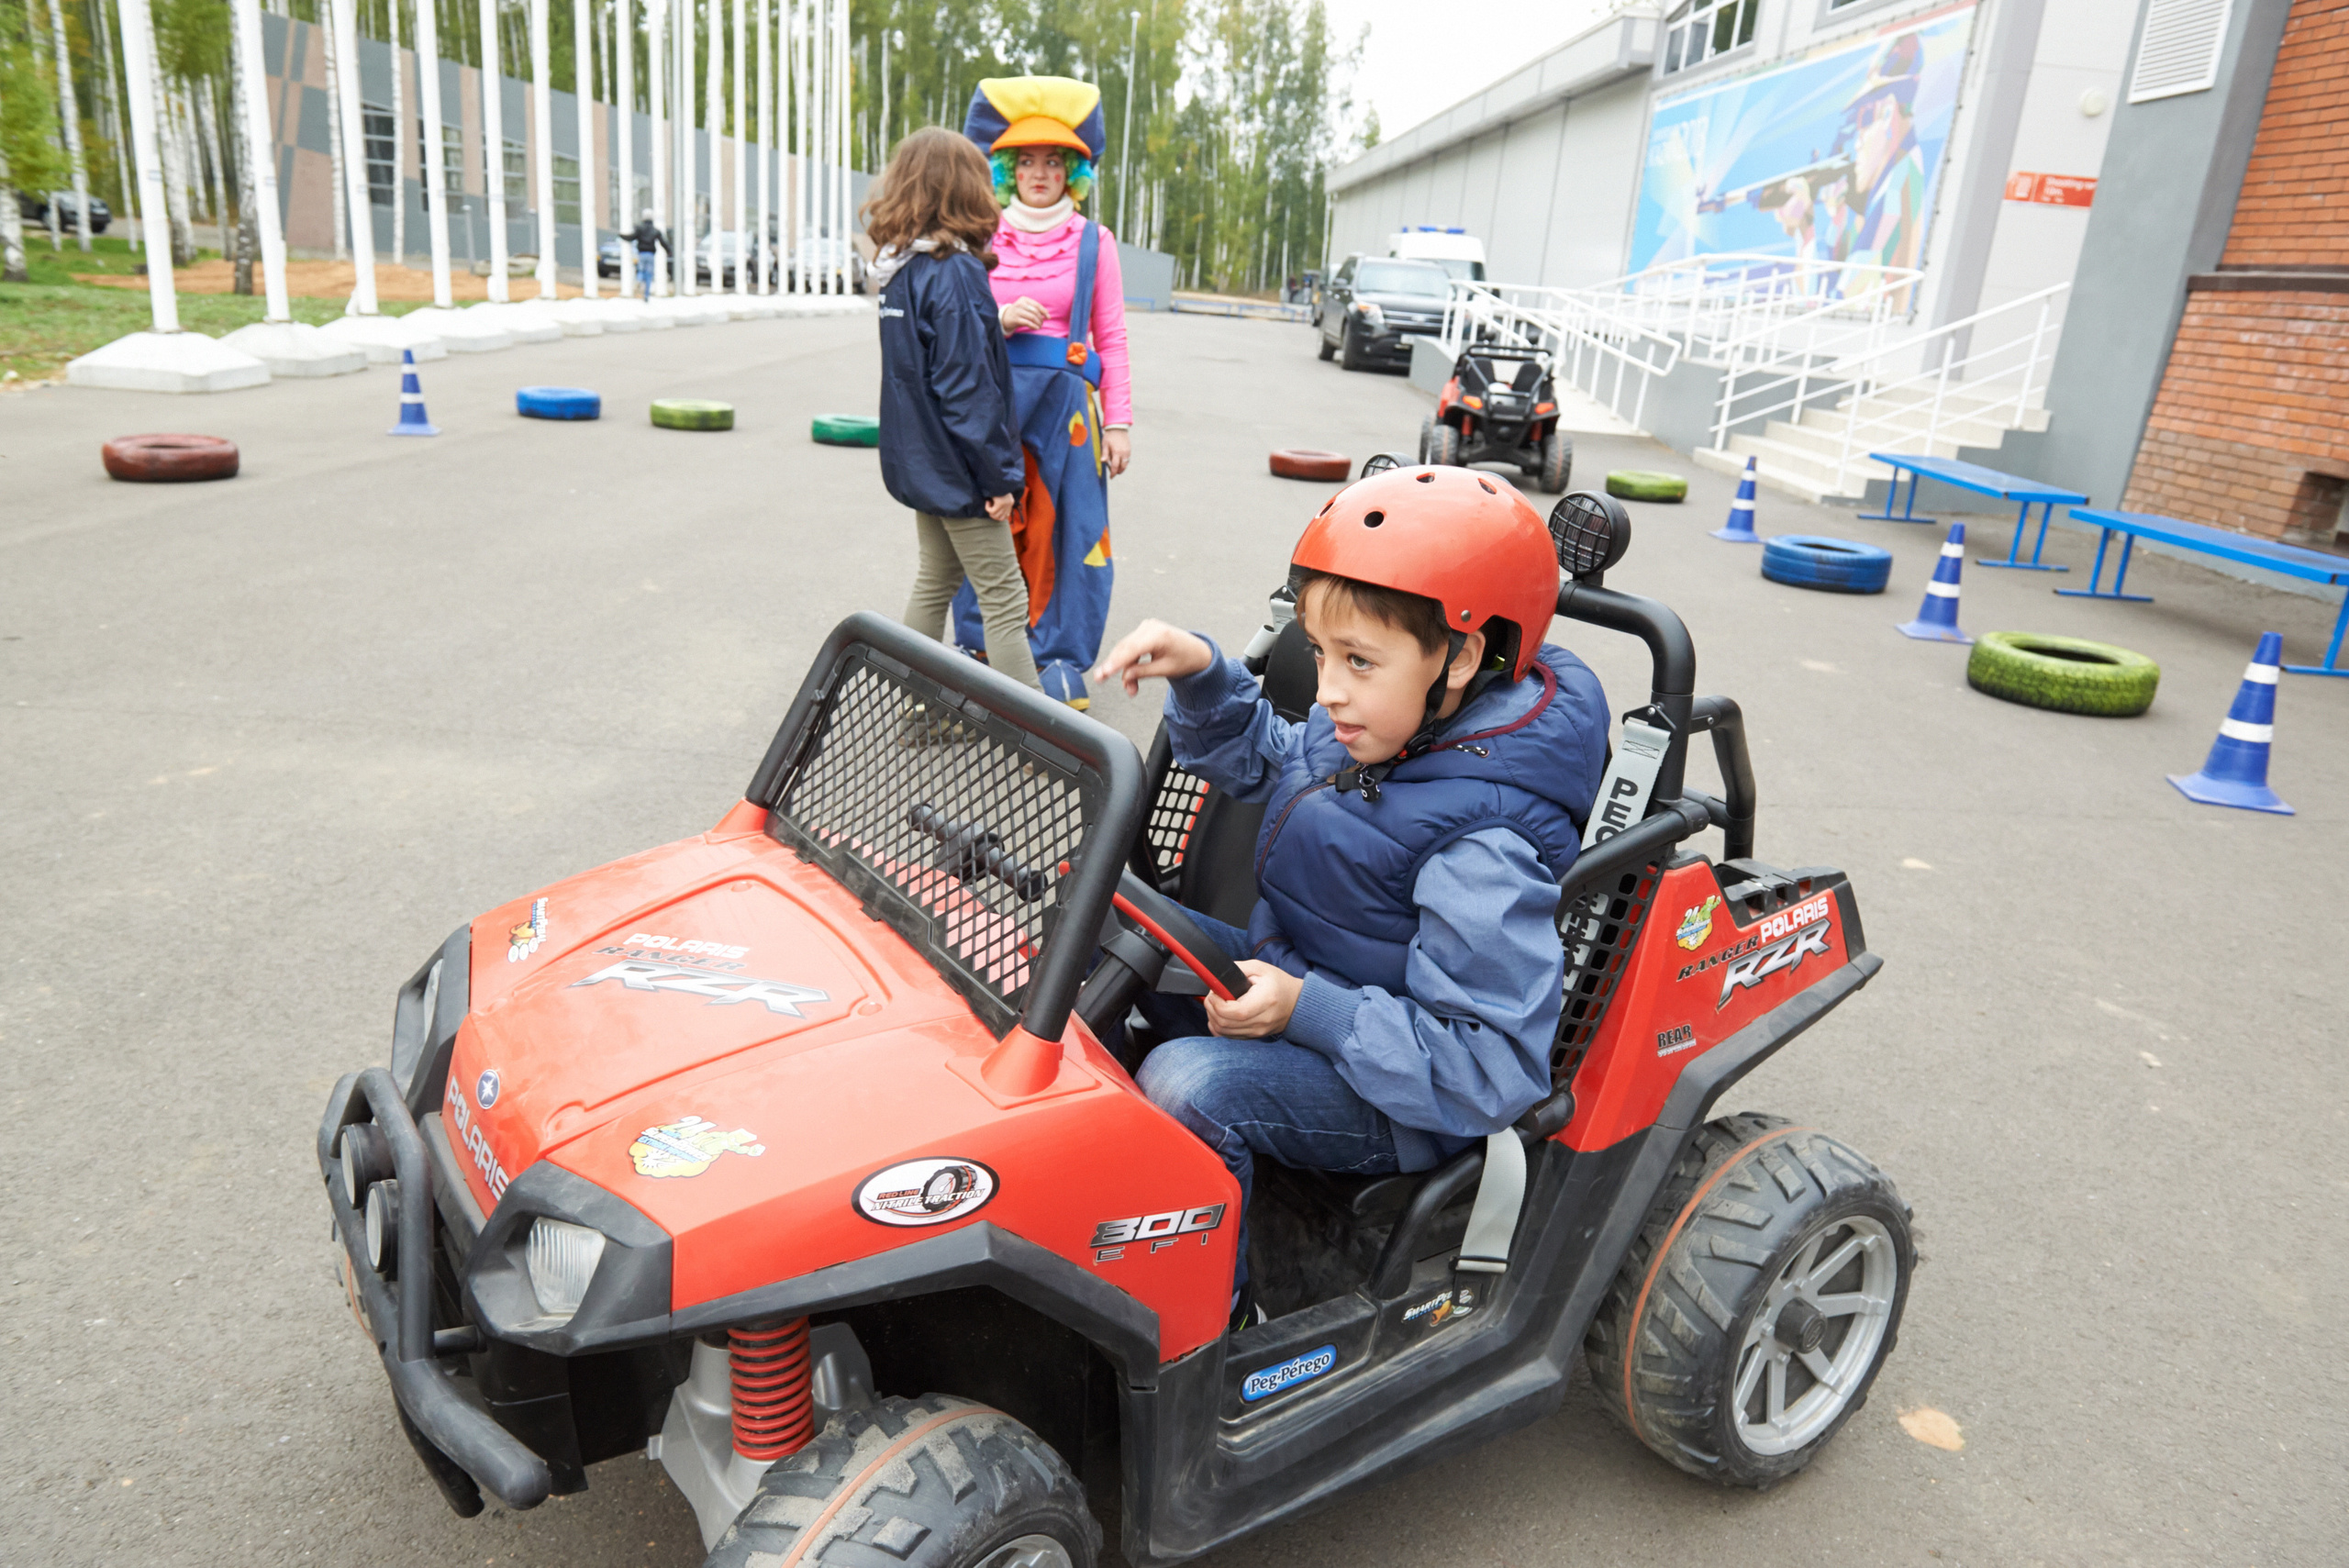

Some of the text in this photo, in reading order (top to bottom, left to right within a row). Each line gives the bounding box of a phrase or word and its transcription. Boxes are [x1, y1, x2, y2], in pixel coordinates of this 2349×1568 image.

[1760, 896, 1829, 942] POLARIS
[593, 946, 747, 971] RANGER
[623, 933, 750, 959] POLARIS
[1676, 935, 1759, 982] RANGER
[1717, 917, 1831, 1013] RZR
[564, 959, 831, 1018] RZR
[1657, 1024, 1692, 1048] REAR
[447, 1074, 510, 1202] POLARIS
[871, 1188, 986, 1211] NITRILE TRACTION
[878, 1191, 898, 1199] RED
[1090, 1203, 1227, 1248] 800
[1250, 1354, 1330, 1394] Peg-Pérego
